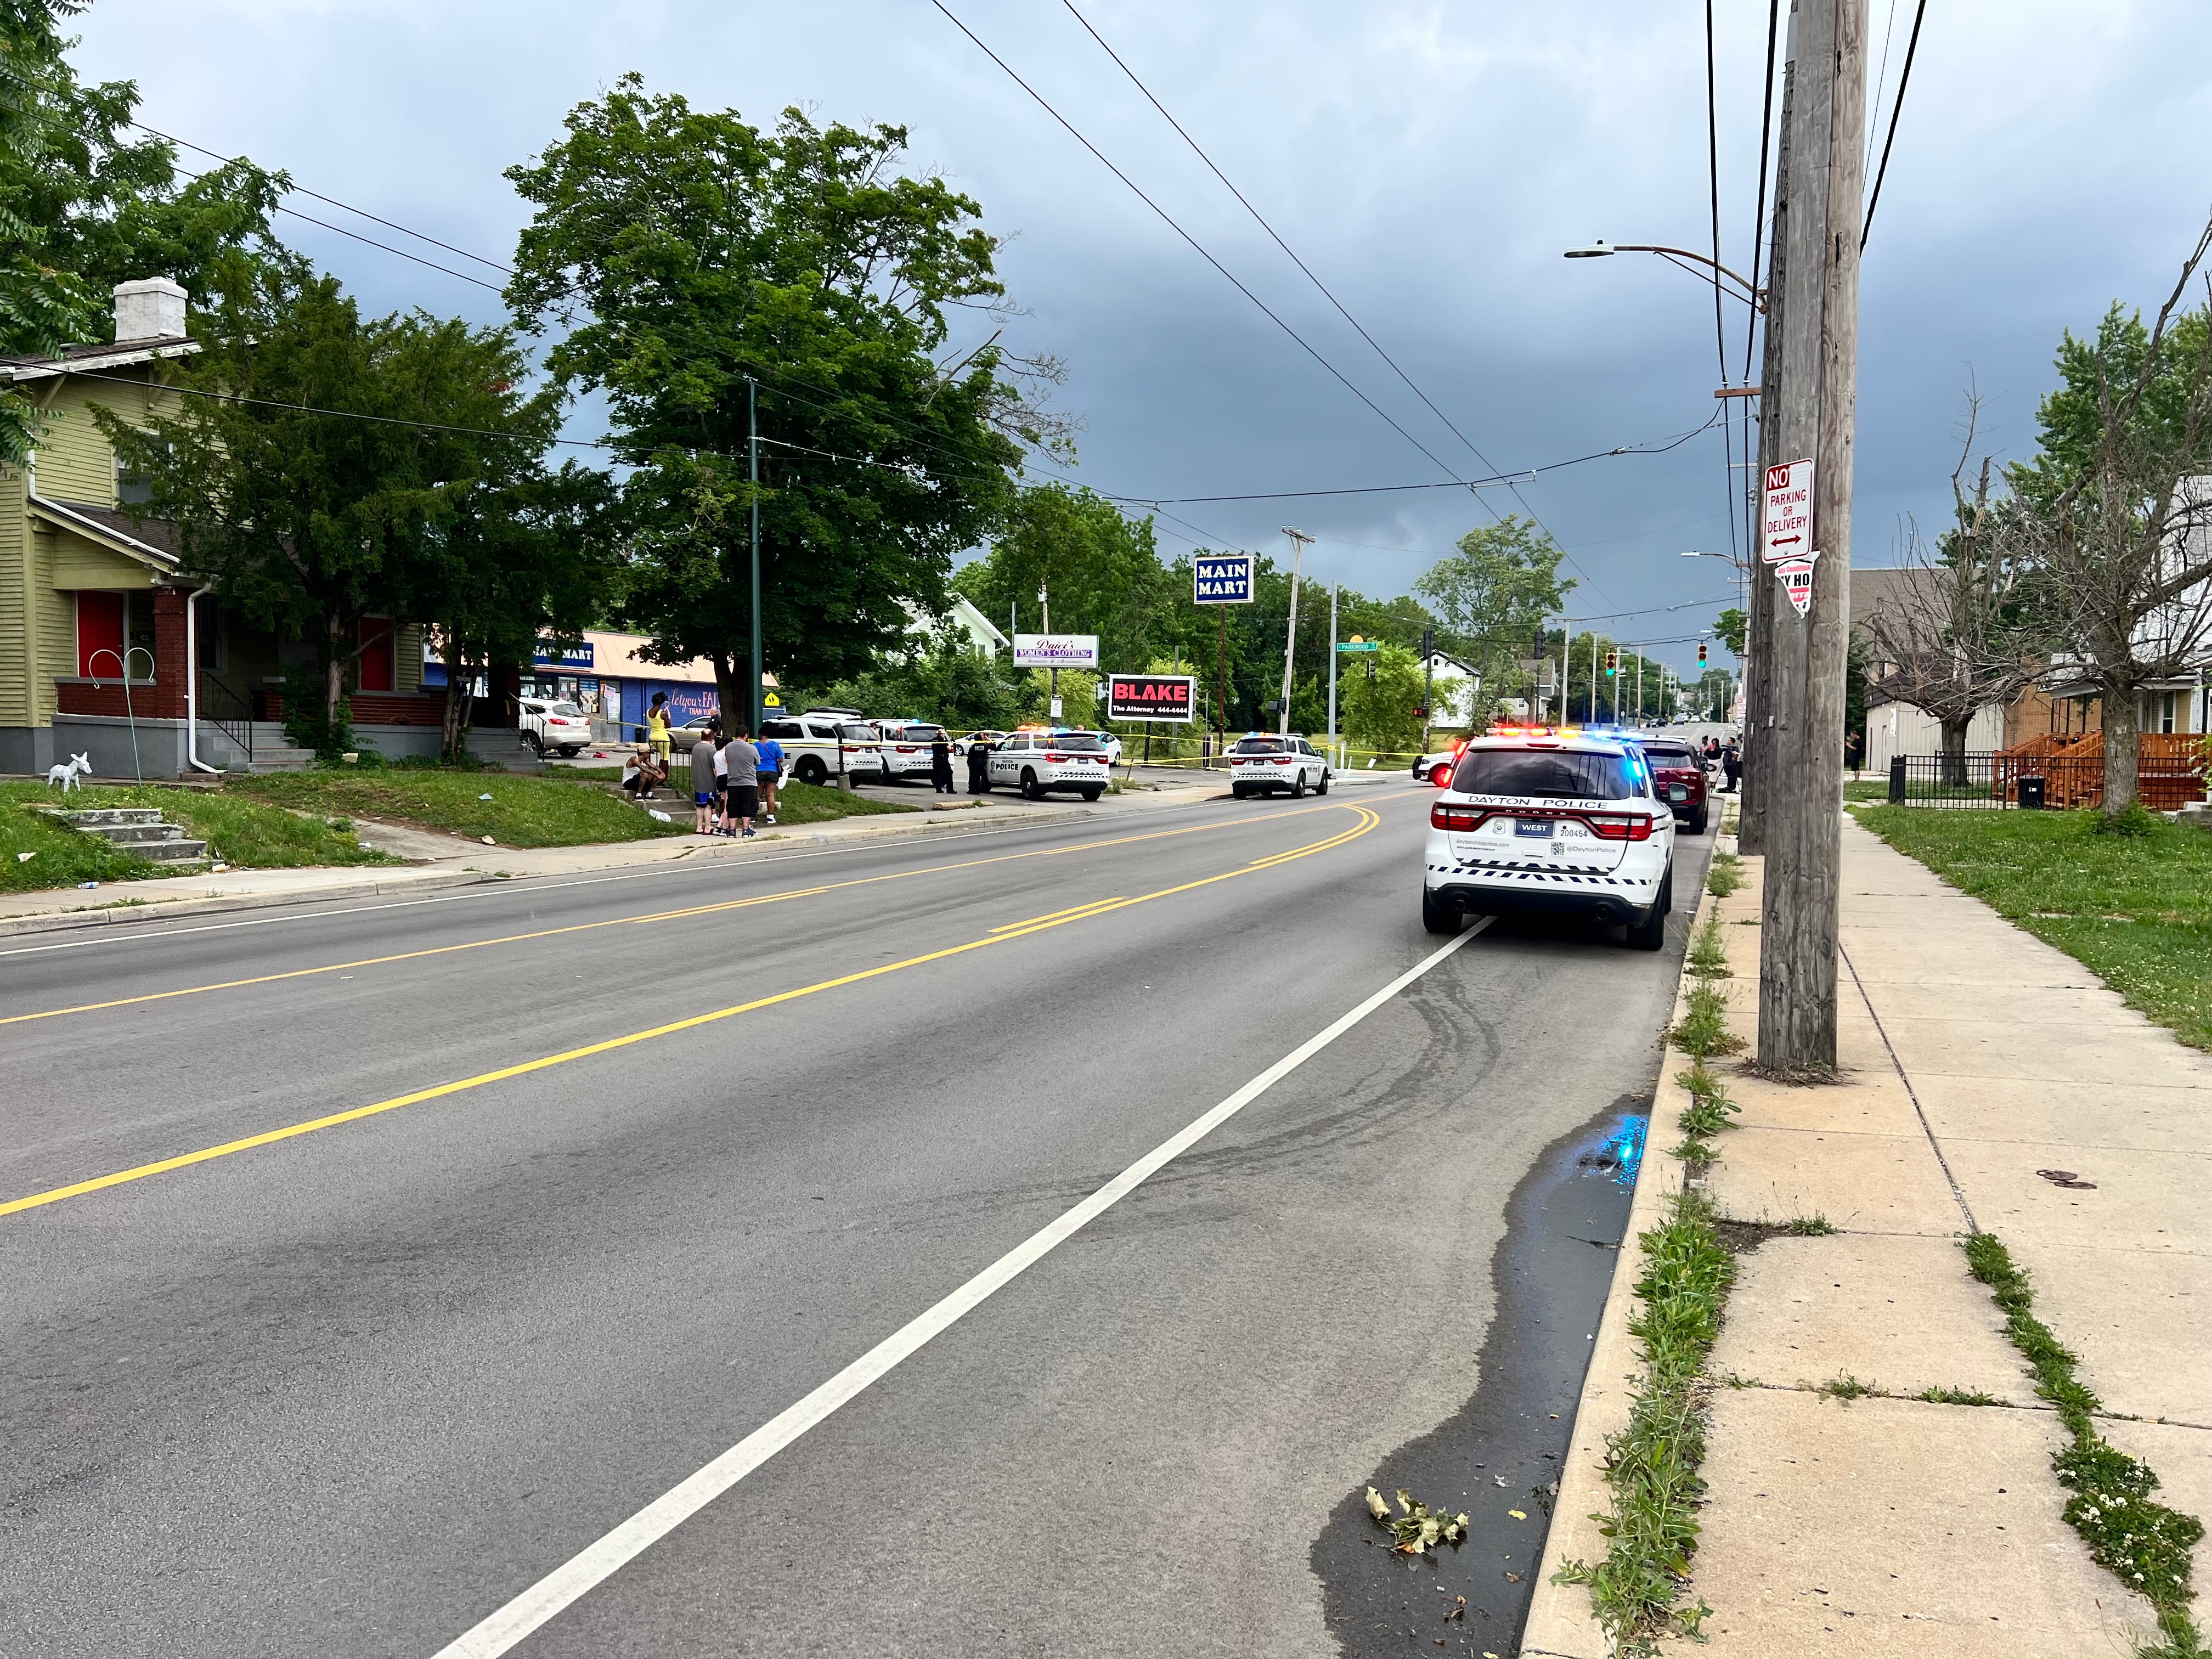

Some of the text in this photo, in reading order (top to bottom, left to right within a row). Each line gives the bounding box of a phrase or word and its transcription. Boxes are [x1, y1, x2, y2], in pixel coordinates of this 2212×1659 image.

[1768, 468, 1788, 489] NO
[1770, 489, 1806, 507] PARKING
[1783, 506, 1793, 516] OR
[1768, 515, 1808, 533] DELIVERY
[1198, 563, 1247, 579] MAIN
[1198, 580, 1246, 595] MART
[562, 648, 592, 660] MART
[1114, 684, 1187, 701] BLAKE
[1469, 796, 1609, 809] DAYTON POLICE
[1456, 839, 1510, 848] daytonohiopolice.com
